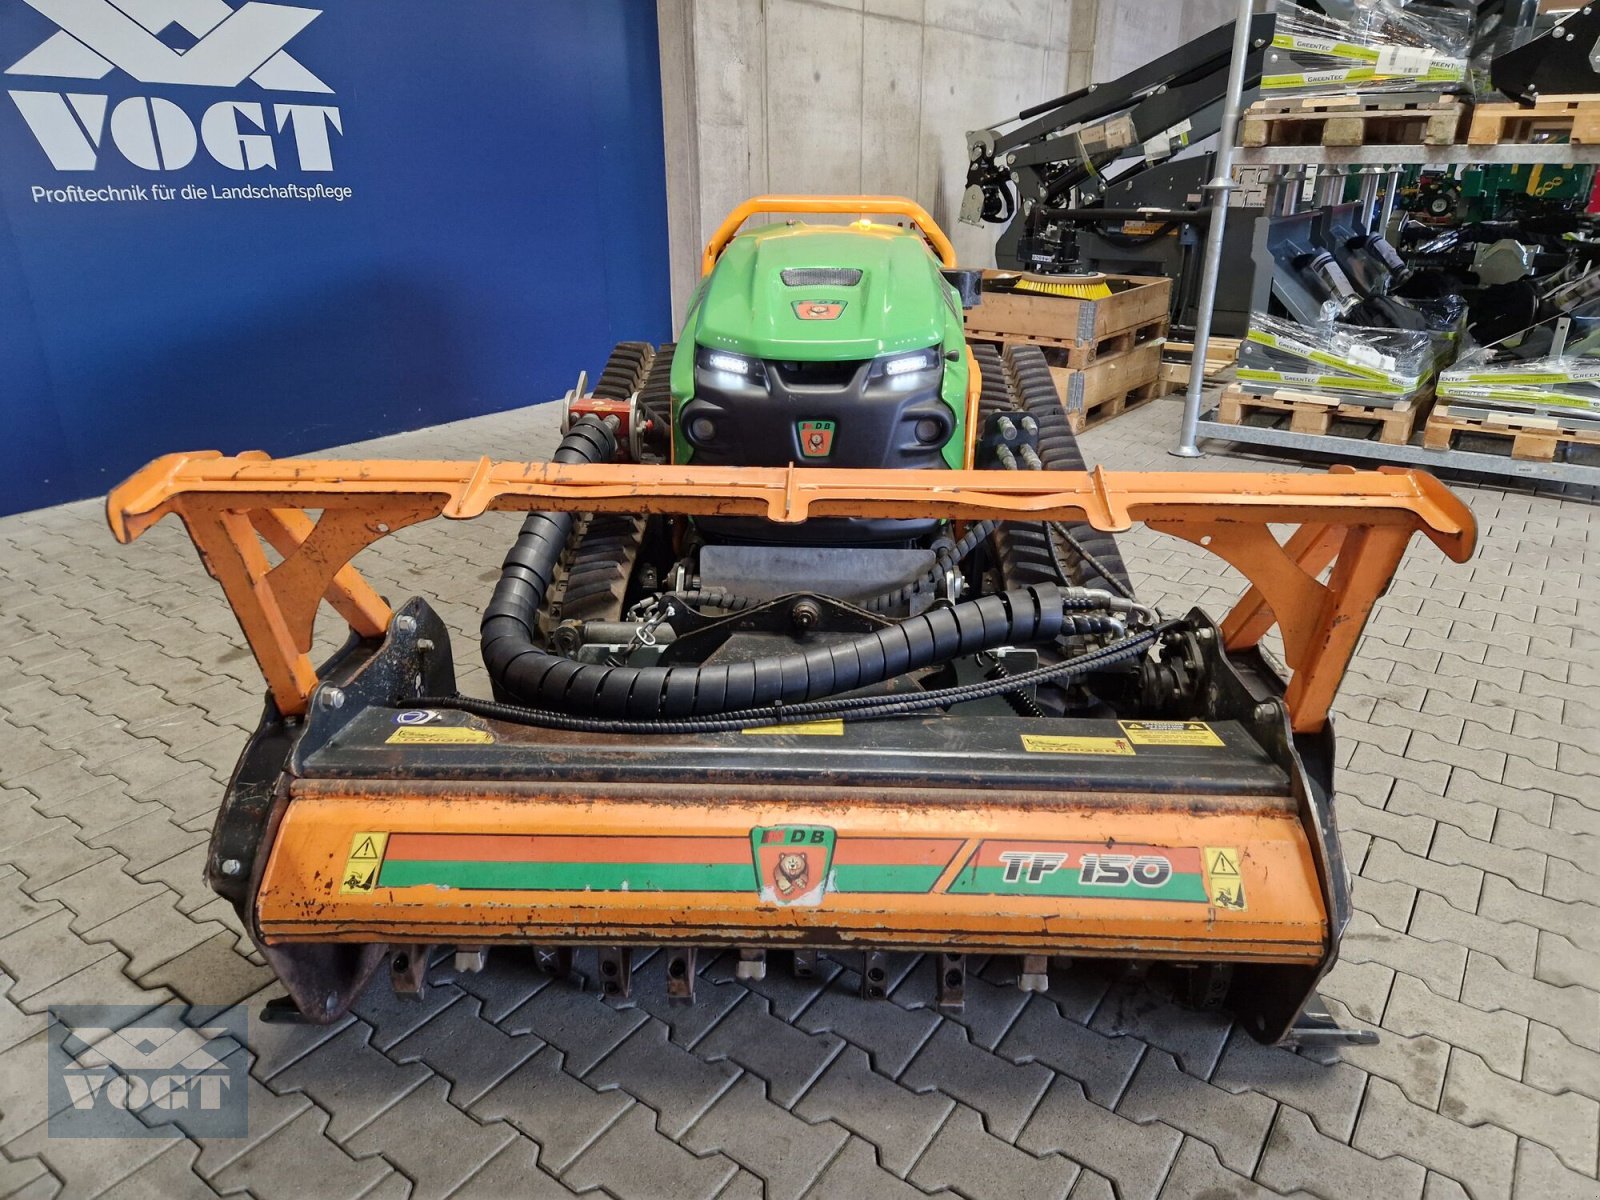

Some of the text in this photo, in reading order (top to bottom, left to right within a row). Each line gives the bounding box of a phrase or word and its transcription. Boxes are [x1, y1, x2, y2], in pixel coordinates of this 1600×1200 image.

[7, 90, 344, 172] VOGT
[31, 183, 352, 203] Profitechnik für die Landschaftspflege
[999, 851, 1173, 888] TF 150
